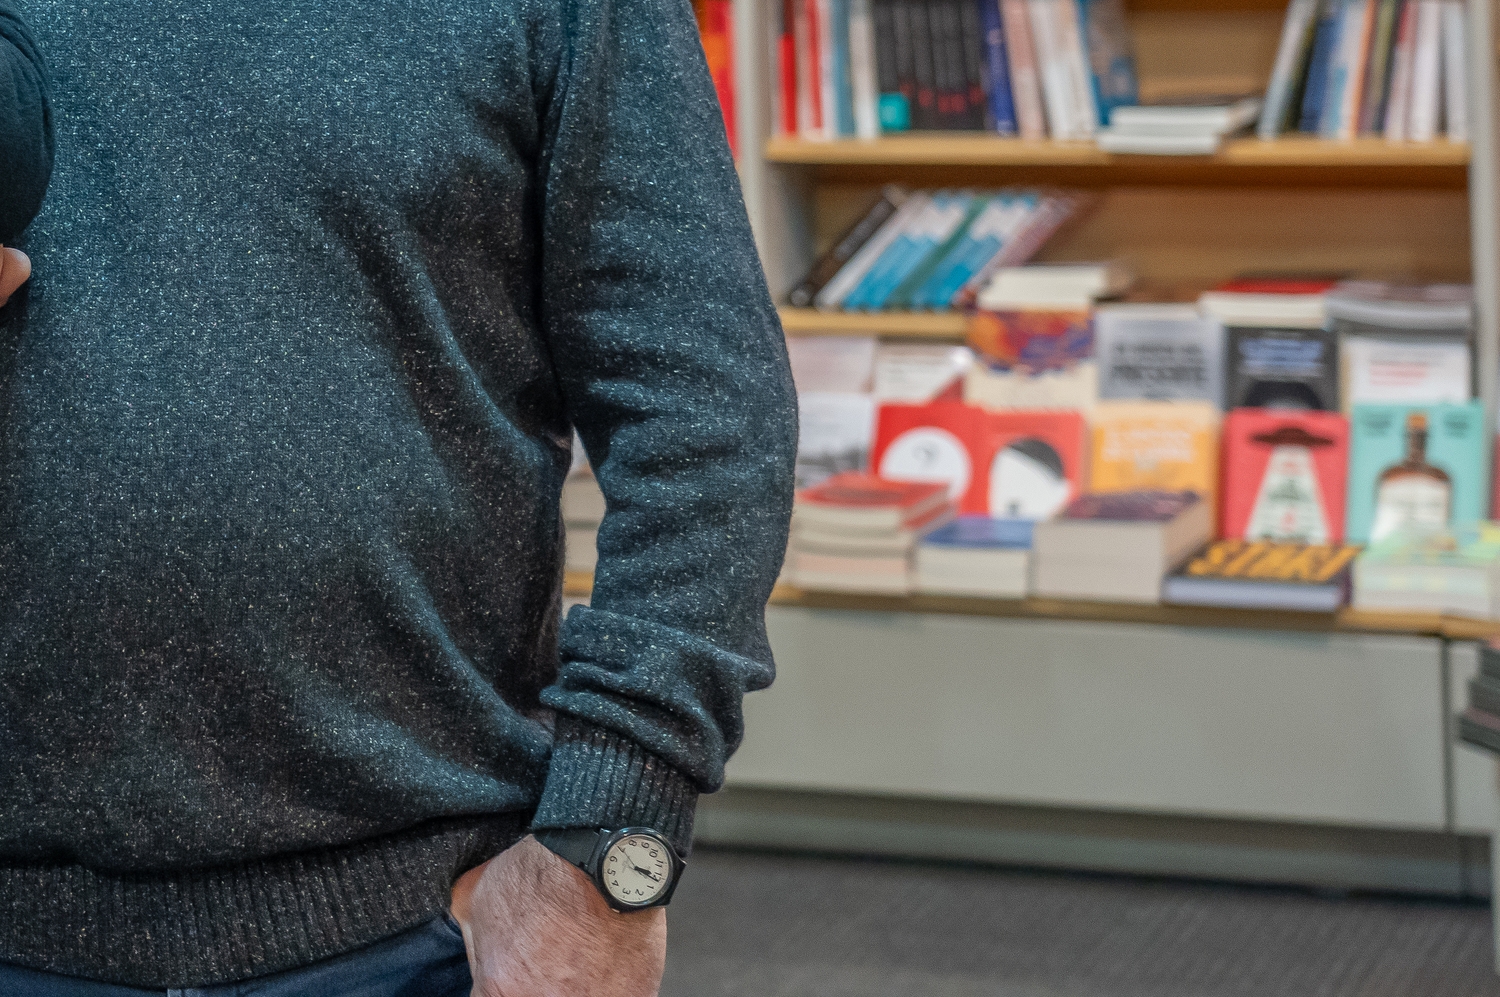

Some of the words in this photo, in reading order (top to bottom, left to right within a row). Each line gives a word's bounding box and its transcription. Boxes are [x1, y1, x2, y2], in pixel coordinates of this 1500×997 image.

[628, 839, 638, 847] 8
[649, 848, 658, 858] 10
[607, 868, 616, 876] 5
